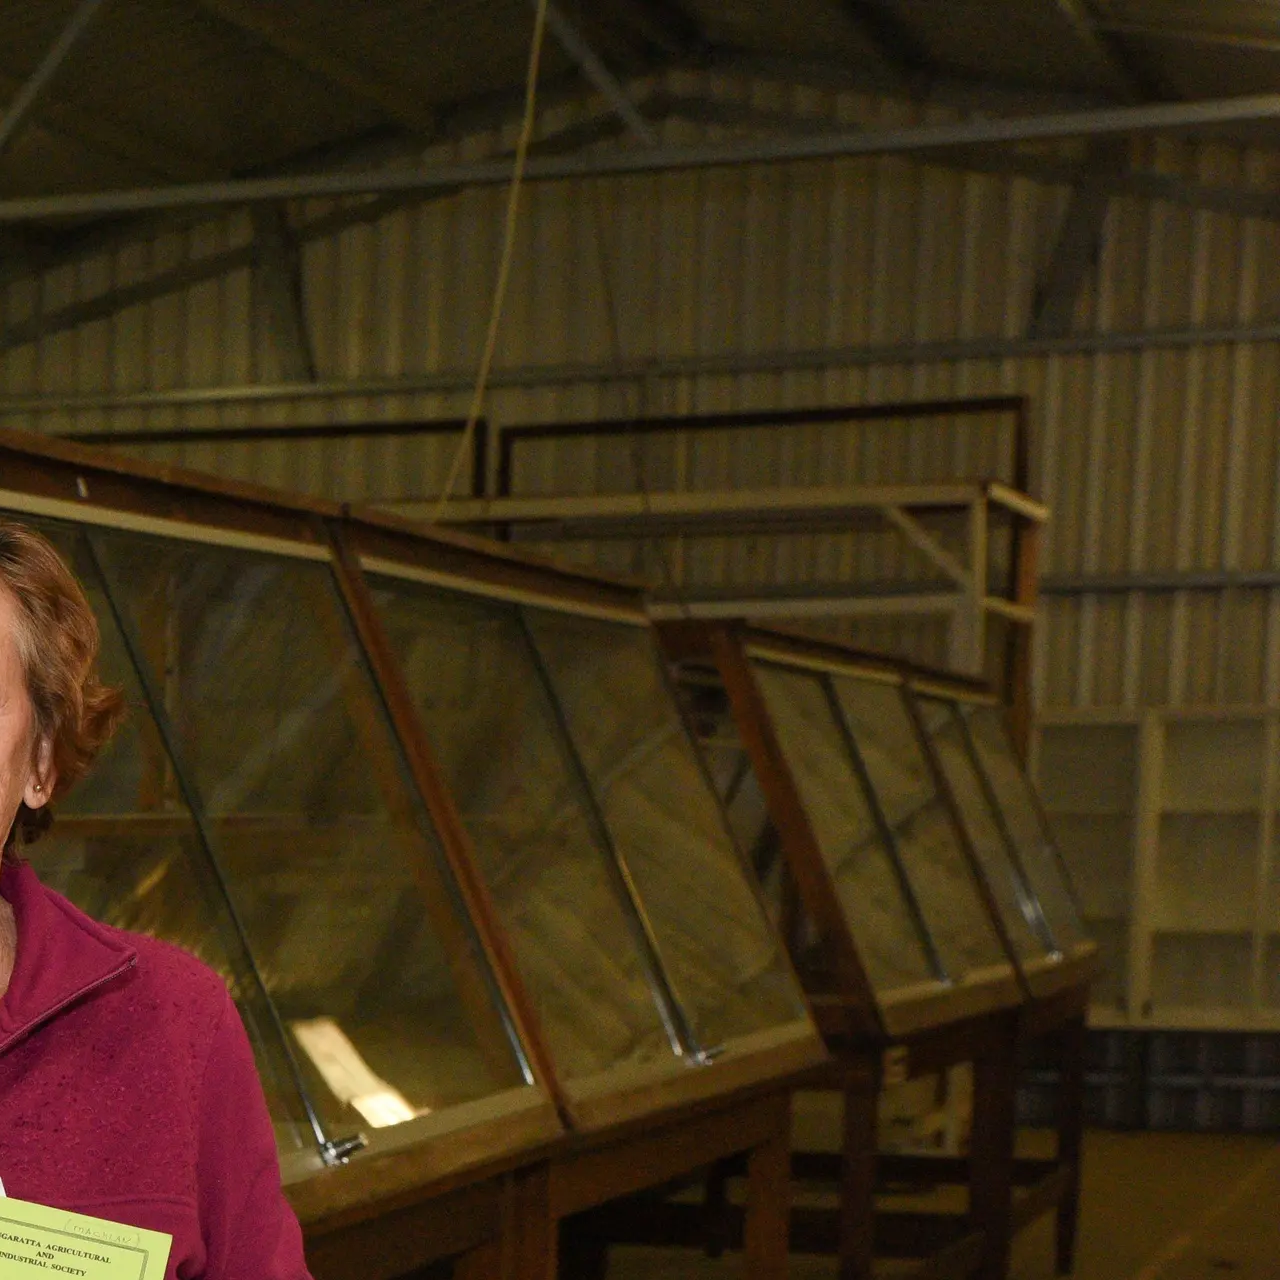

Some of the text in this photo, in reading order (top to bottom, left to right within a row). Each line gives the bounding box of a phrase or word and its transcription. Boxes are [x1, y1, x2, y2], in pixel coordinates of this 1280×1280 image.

[36, 1251, 55, 1260] AND
[45, 1244, 112, 1264] AGRICULTURAL
[51, 1263, 87, 1277] SOCIETY
